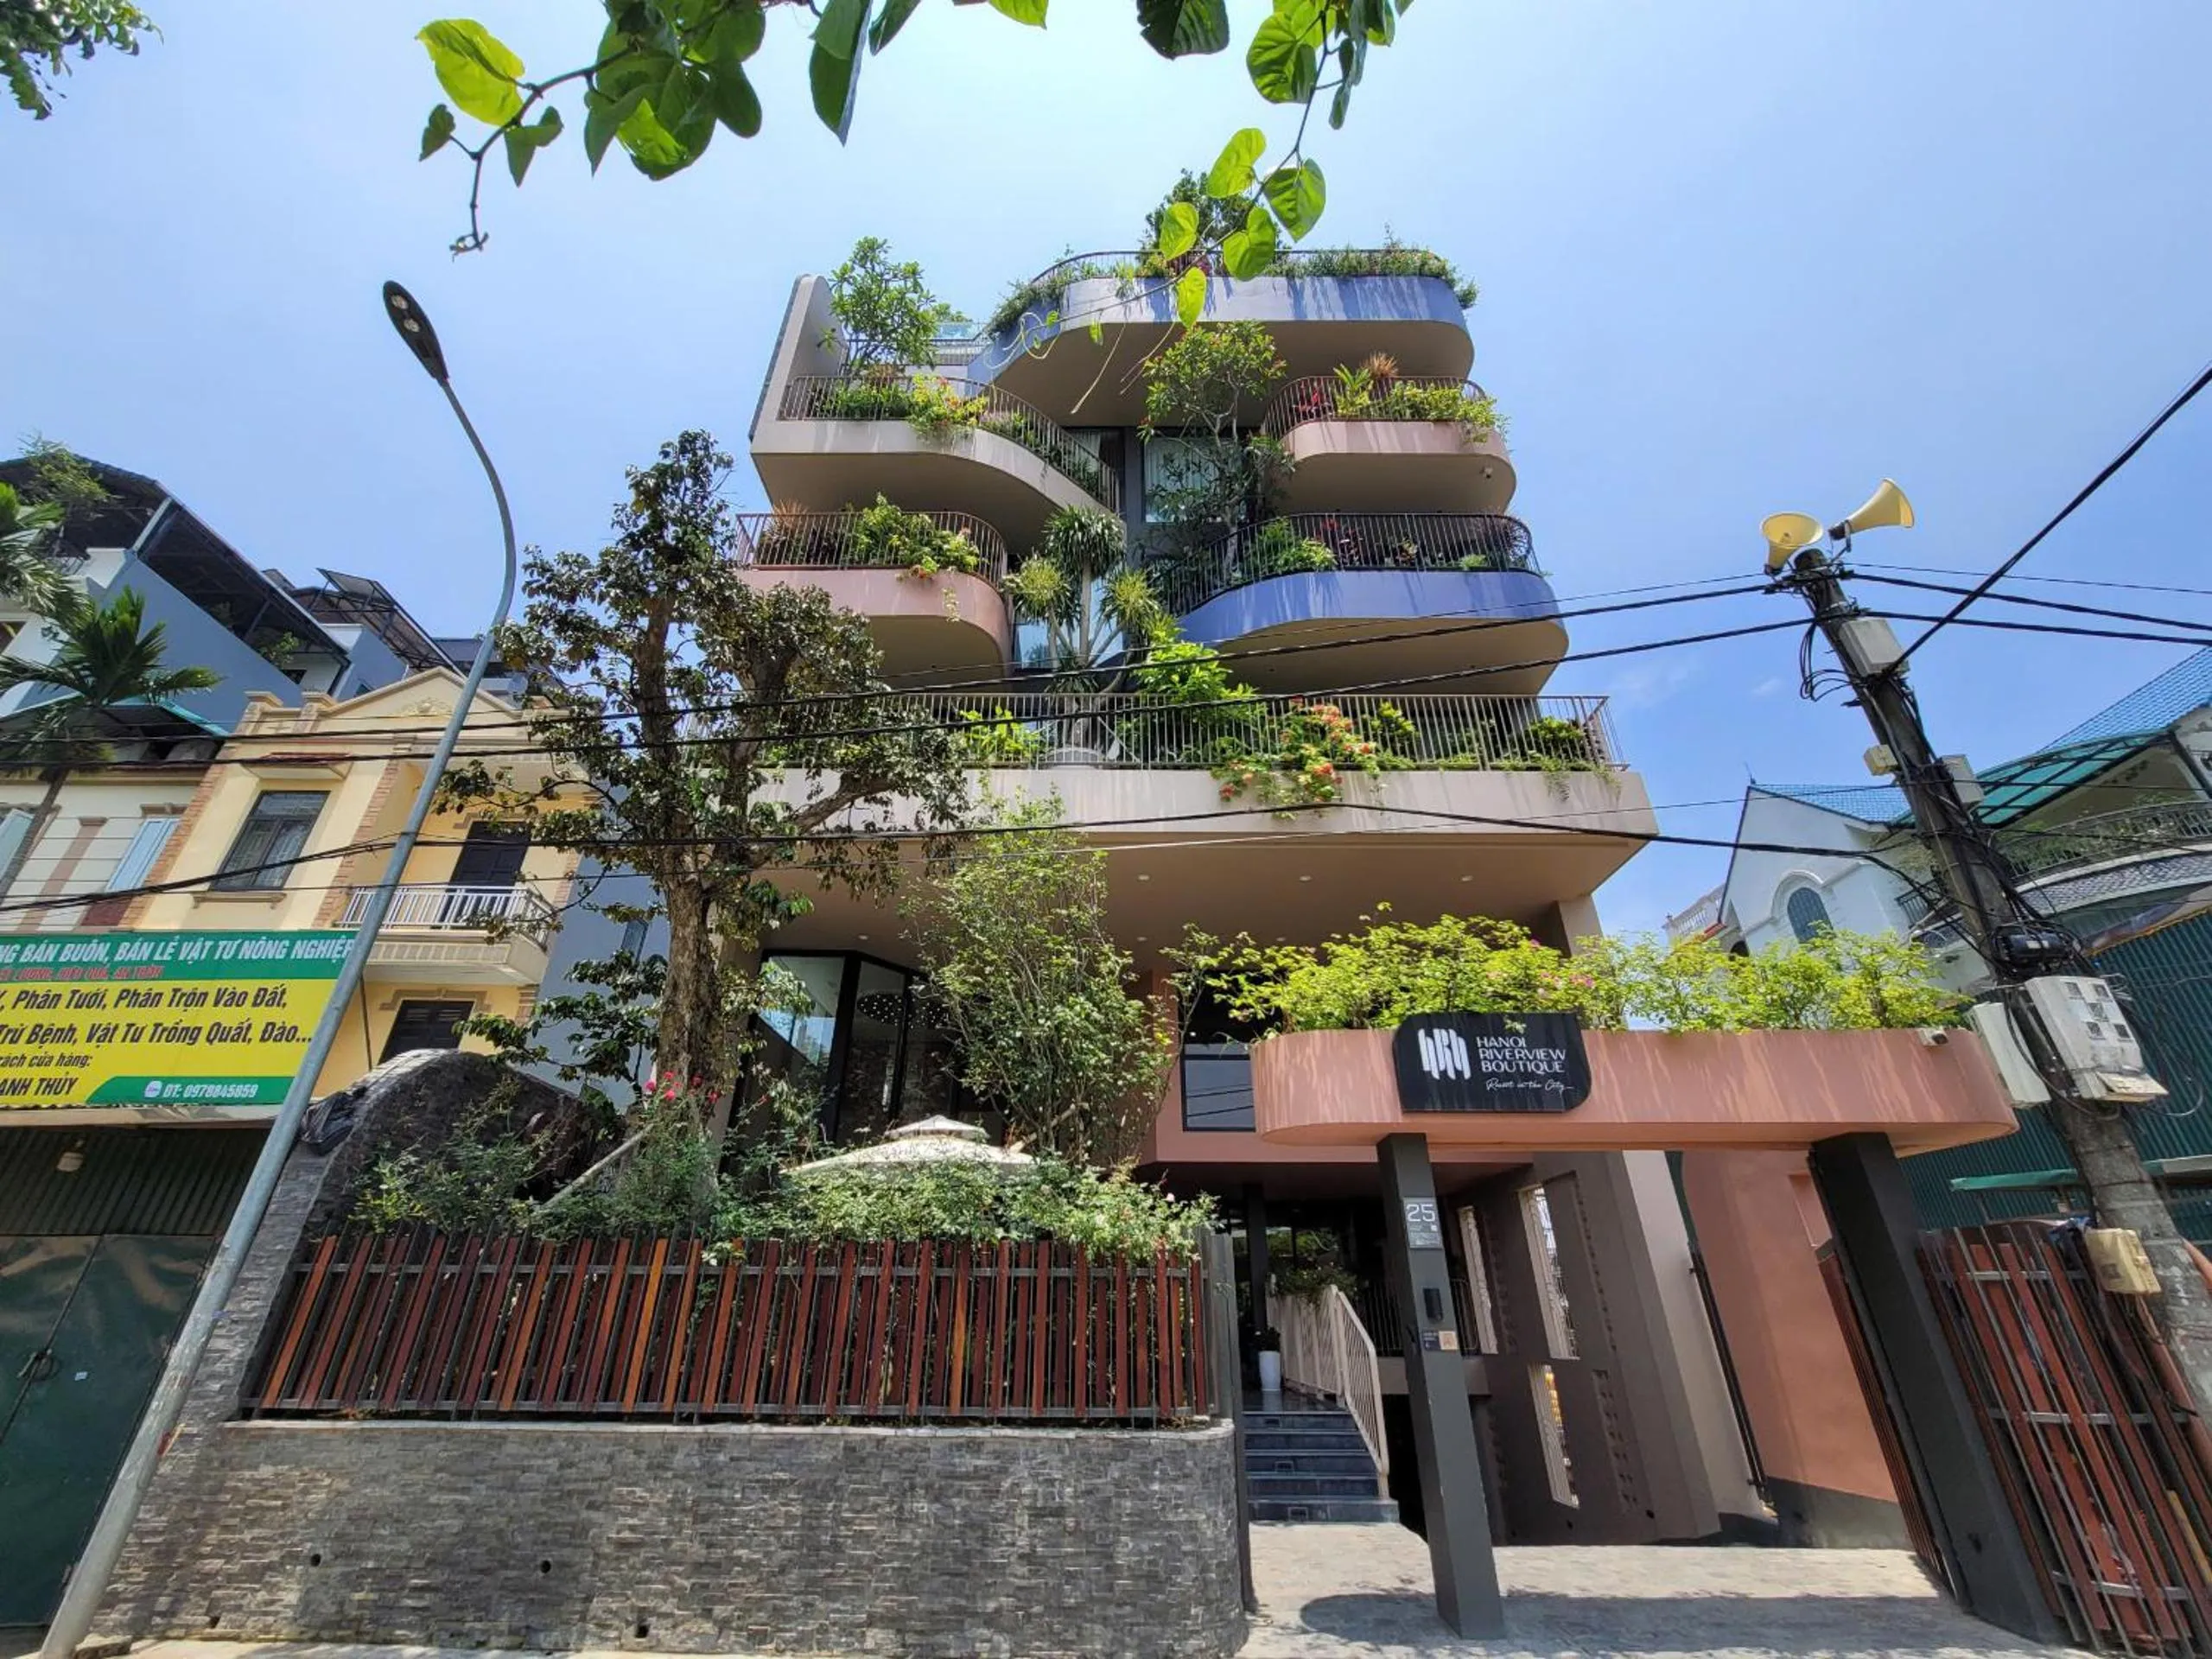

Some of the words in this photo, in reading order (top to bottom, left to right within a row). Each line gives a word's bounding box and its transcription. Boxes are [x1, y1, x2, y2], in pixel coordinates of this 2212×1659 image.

[19, 939, 61, 963] BÁN
[60, 939, 111, 964] BUÔN,
[113, 938, 156, 962] BÁN
[178, 938, 214, 965] VẬT
[214, 939, 243, 960] TƯ
[238, 937, 290, 960] NÔNG
[11, 988, 63, 1010] Phân
[65, 988, 109, 1011] Tưới,
[112, 988, 164, 1009] Phân
[167, 987, 209, 1013] Trộn
[251, 983, 288, 1009] Đất,
[24, 1023, 79, 1049] Bệnh,
[86, 1022, 119, 1048] Vật
[119, 1022, 149, 1044] Tư
[206, 1018, 254, 1046] Quất,
[1476, 1036, 1527, 1048] HANOI
[1478, 1048, 1567, 1060] RIVERVIEW
[1481, 1060, 1566, 1074] BOUTIQUE
[1406, 1204, 1436, 1222] 25
